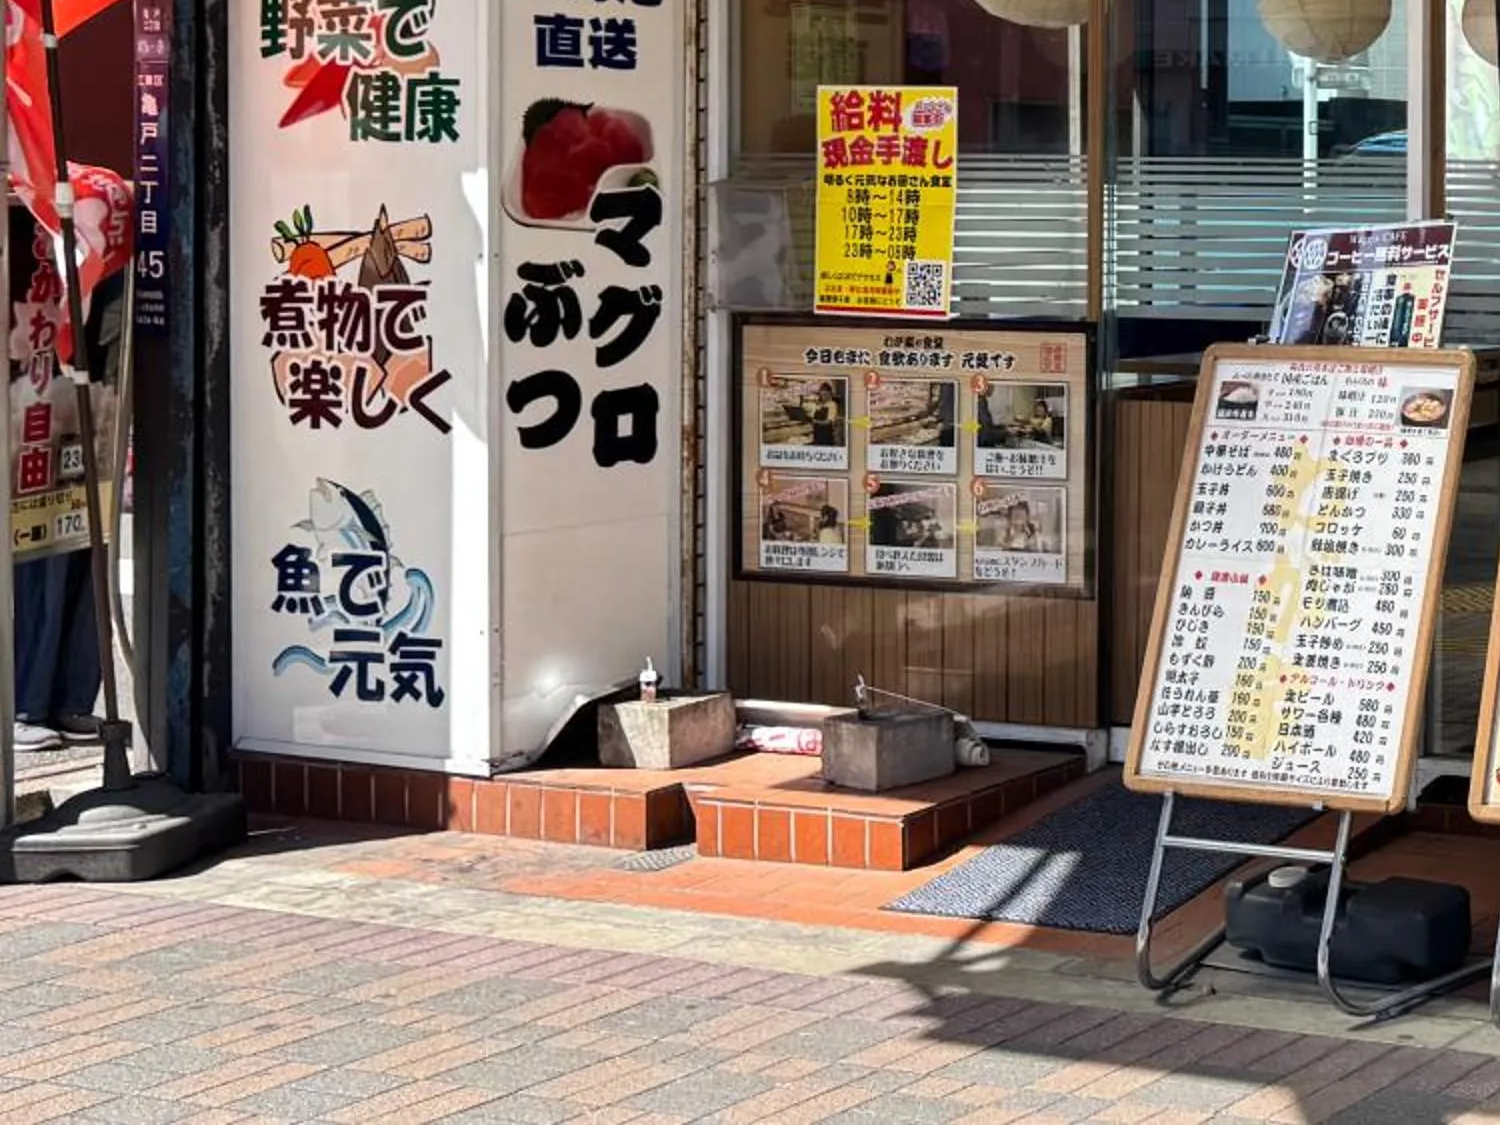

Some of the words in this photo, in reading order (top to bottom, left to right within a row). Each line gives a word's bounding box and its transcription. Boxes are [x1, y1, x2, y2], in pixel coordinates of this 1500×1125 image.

[533, 13, 638, 70] 直送
[345, 71, 461, 144] 健康
[830, 90, 903, 133] 給料
[140, 92, 160, 235] 亀戸二丁目
[821, 134, 953, 170] 現金手渡し
[259, 278, 430, 353] 煮物で
[588, 186, 664, 468] マグロ
[503, 258, 585, 450] ぶつ
[287, 361, 454, 435] 楽しく
[271, 541, 391, 619] 魚で
[328, 628, 445, 709] 元気
